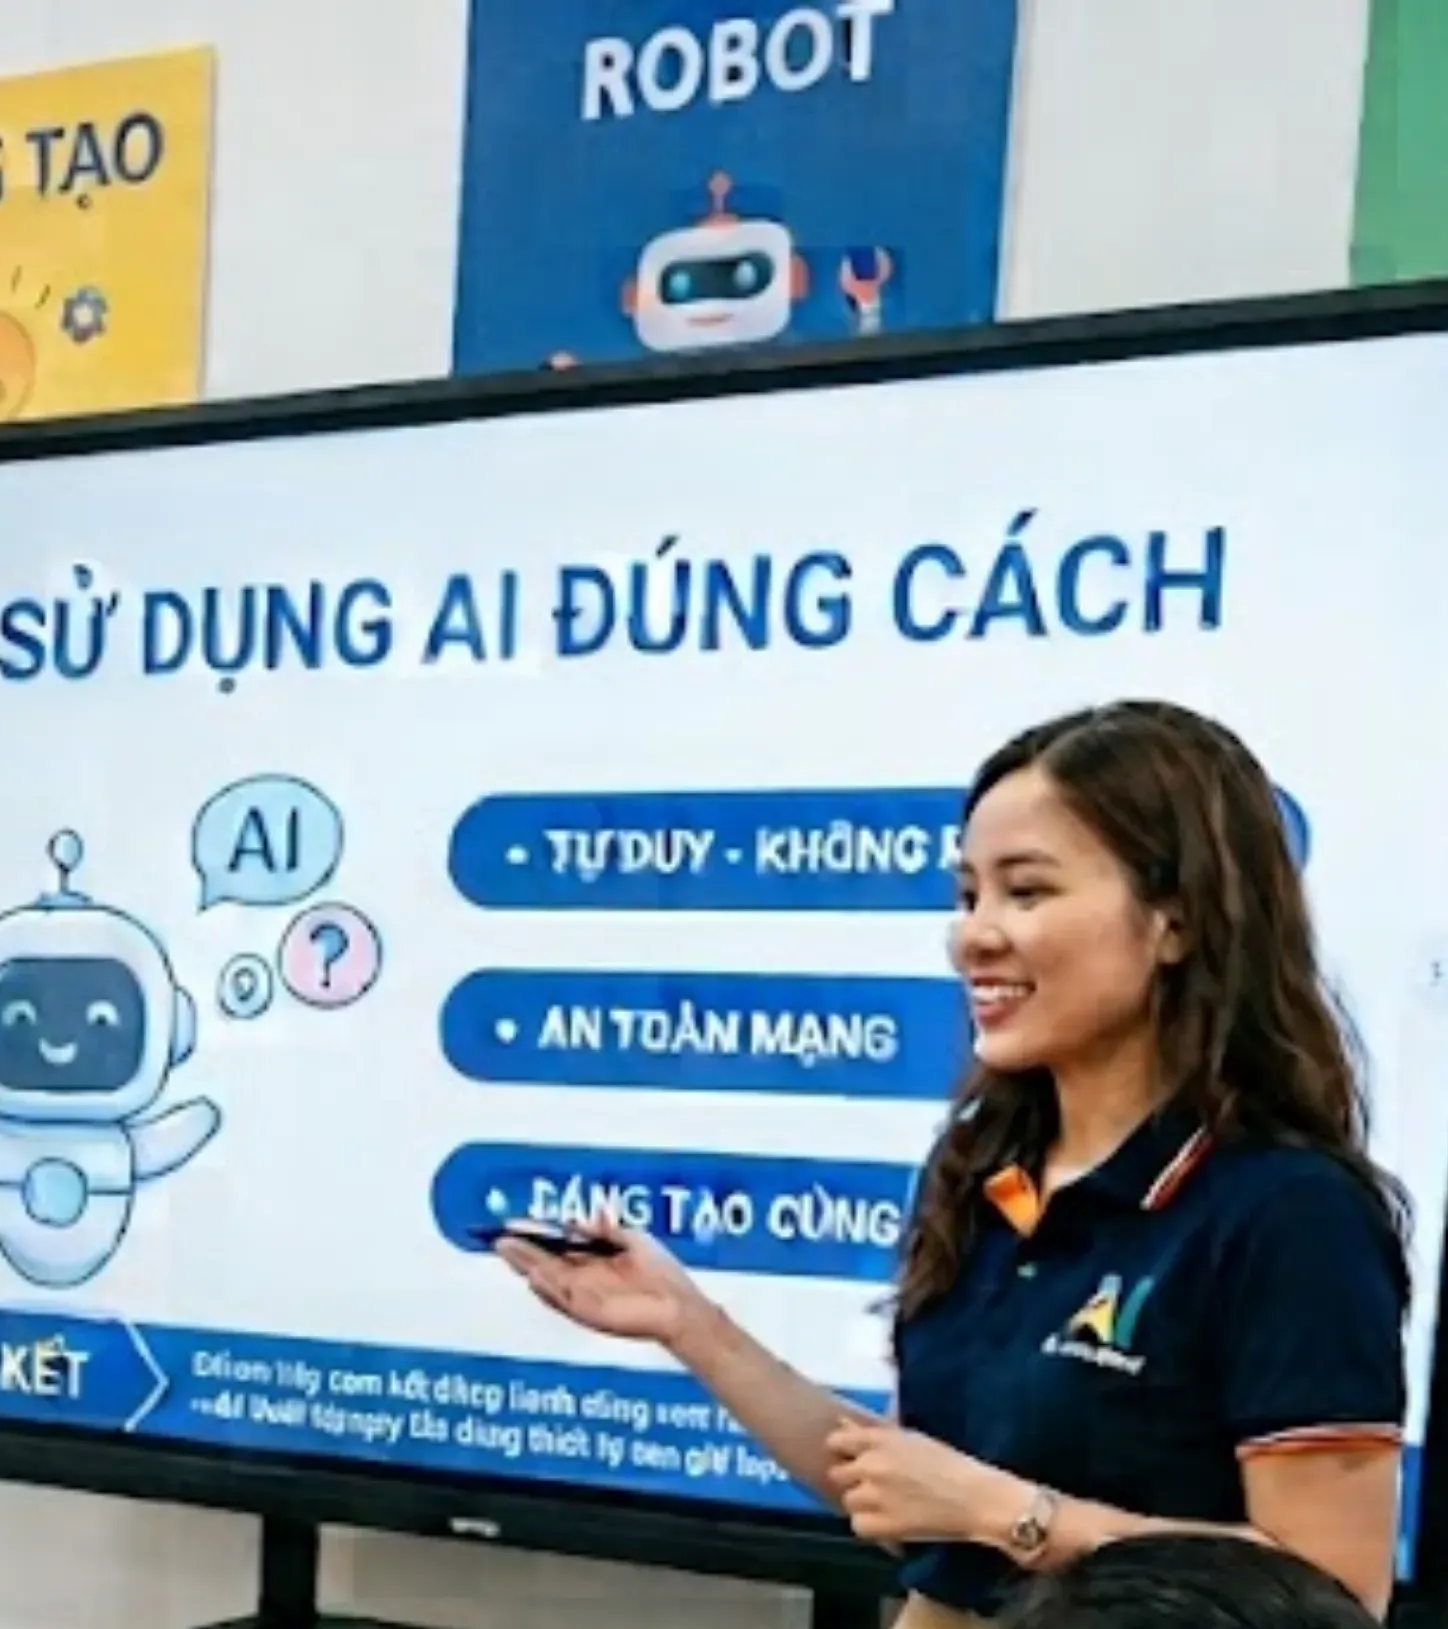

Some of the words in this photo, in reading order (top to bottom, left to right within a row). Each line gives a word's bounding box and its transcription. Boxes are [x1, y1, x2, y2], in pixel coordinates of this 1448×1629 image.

[579, 0, 896, 121] ROBOT
[25, 112, 165, 211] TẠO
[142, 571, 394, 695] DỤNG
[422, 569, 518, 667] AI
[551, 533, 856, 661] ĐÚNG
[891, 507, 1228, 646] CÁCH
[226, 806, 302, 874] AI
[537, 1004, 603, 1051] AN
[749, 1009, 901, 1069] MẠNG
